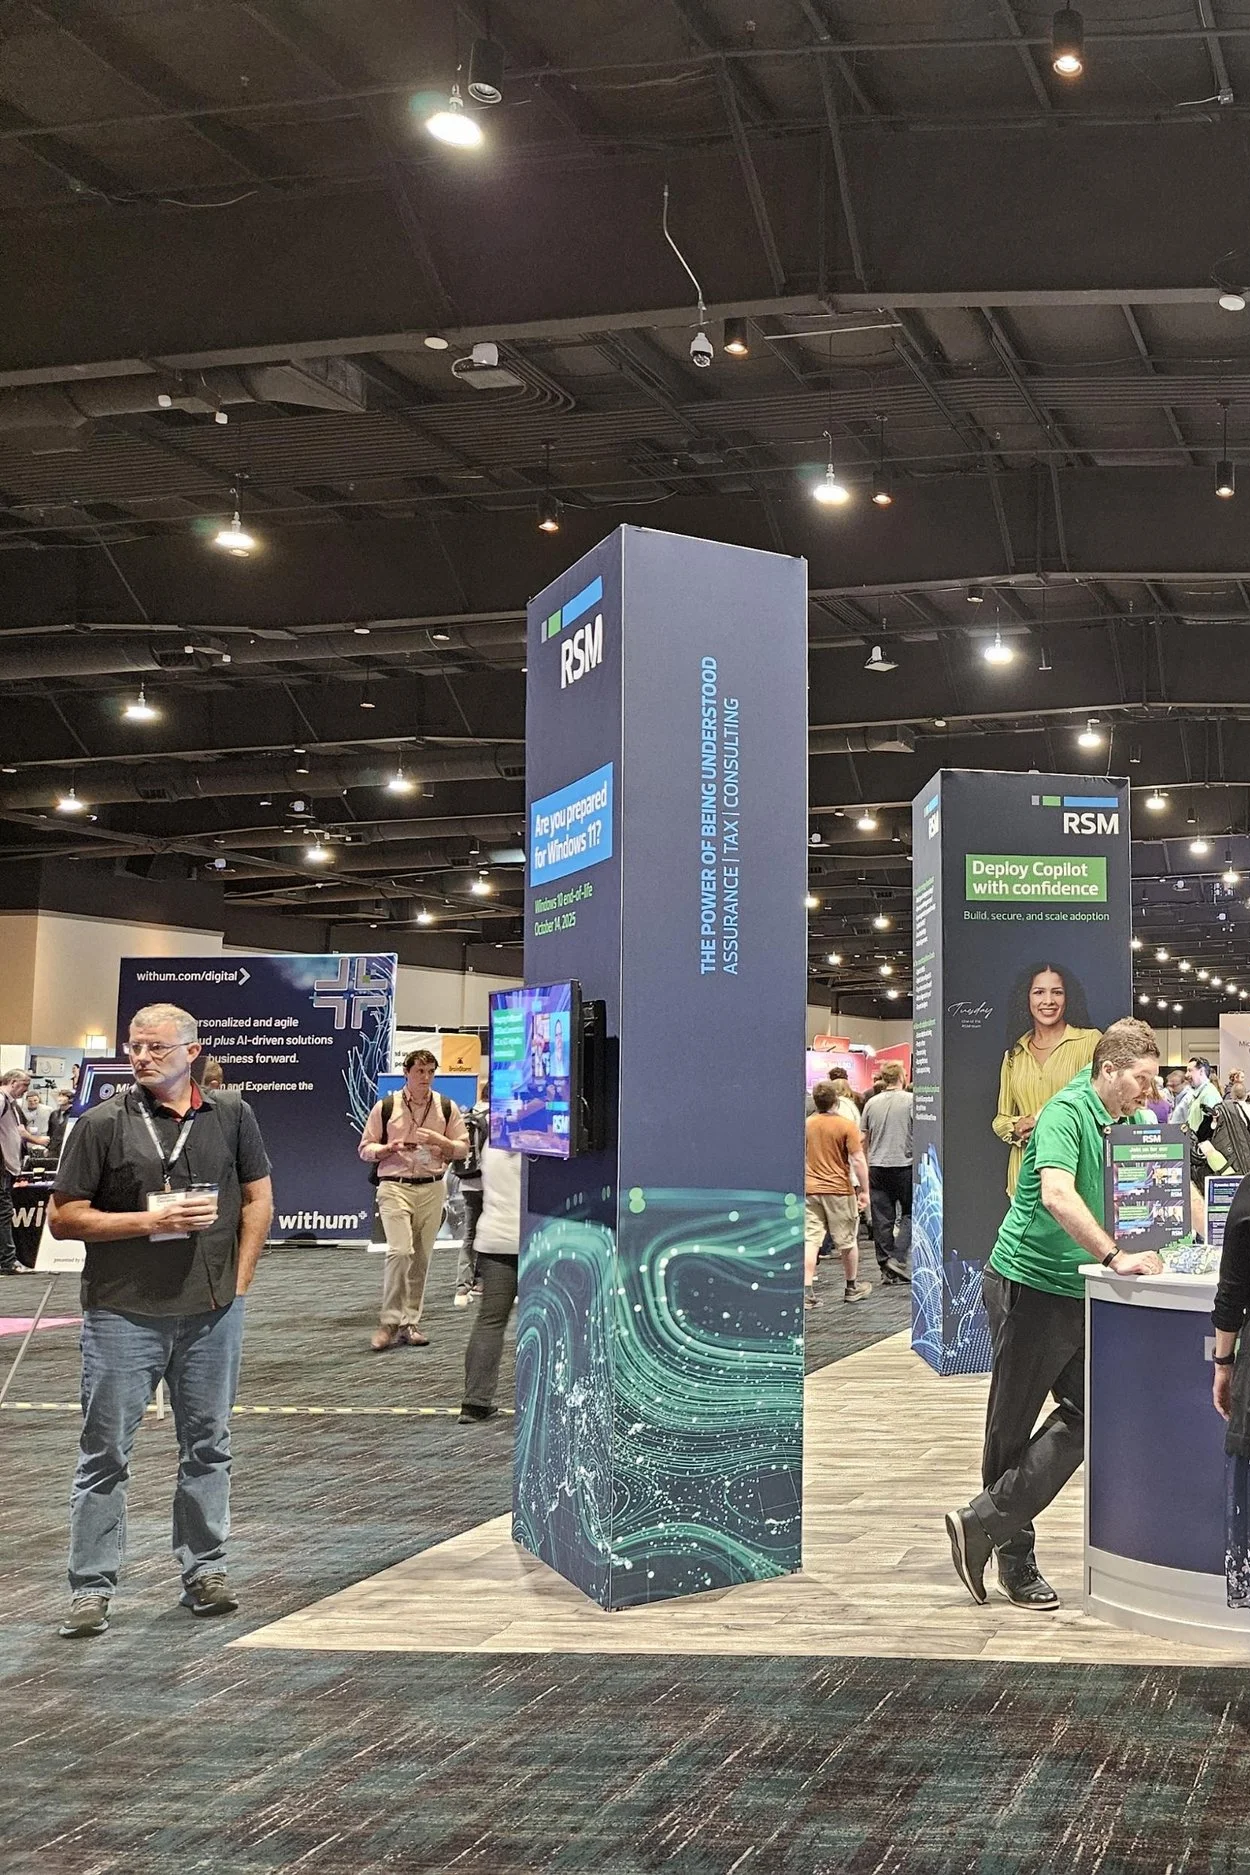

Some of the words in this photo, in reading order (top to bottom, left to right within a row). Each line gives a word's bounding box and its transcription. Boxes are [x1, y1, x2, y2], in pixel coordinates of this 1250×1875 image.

[561, 613, 603, 689] RSM
[701, 656, 718, 780] UNDERSTOOD
[723, 698, 739, 808] CONSULTING
[535, 814, 549, 838] Are
[549, 810, 566, 838] you
[566, 781, 607, 830] prepared
[701, 783, 717, 837] BEING
[723, 820, 739, 853] TAX
[1063, 813, 1119, 835] RSM
[535, 846, 547, 869] for
[547, 831, 586, 865] Windows
[587, 819, 602, 847] 11?
[701, 840, 717, 865] OF
[972, 860, 1029, 880] Deploy
[1032, 861, 1088, 879] Copilot
[535, 897, 557, 914] Windows
[556, 893, 563, 910] 10
[563, 882, 593, 906] end-of-life
[973, 880, 1009, 895] with
[1012, 880, 1099, 896] confidence
[701, 869, 717, 936] POWER
[535, 920, 554, 937] October
[562, 912, 576, 930] 2025
[723, 867, 738, 975] ASSURANCE
[964, 911, 989, 921] Build,
[991, 912, 1024, 922] secure,
[1026, 911, 1043, 921] and
[1045, 911, 1069, 921] scale
[1070, 912, 1110, 923] adoption
[701, 939, 716, 975] THE
[137, 969, 238, 986] withum.com/digital
[948, 1001, 994, 1019] Tuesday
[198, 1016, 252, 1028] rsonalized
[253, 1017, 272, 1027] and
[274, 1017, 299, 1030] agile
[213, 1035, 235, 1048] plus
[237, 1035, 284, 1045] AI-driven
[286, 1034, 333, 1045] solutions
[256, 1053, 299, 1063] forward.
[246, 1081, 296, 1093] Experience
[298, 1081, 314, 1091] the
[1143, 1135, 1161, 1143] RSM
